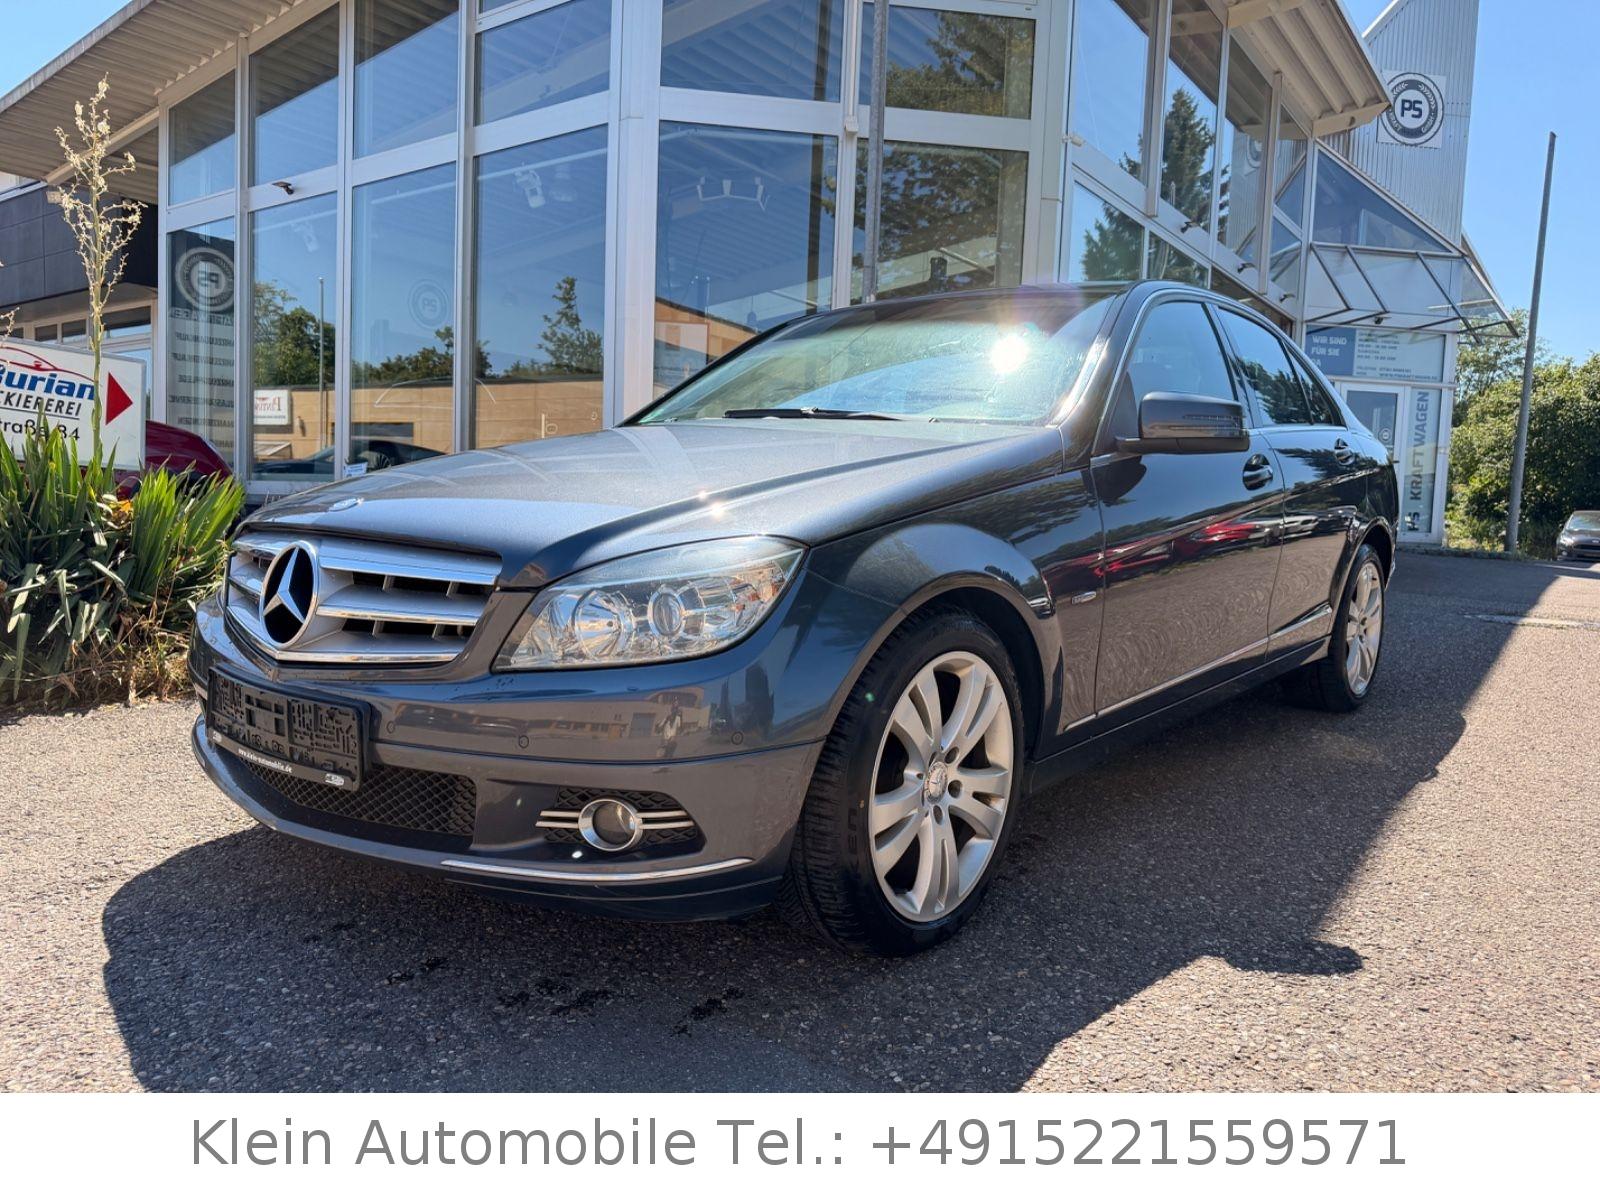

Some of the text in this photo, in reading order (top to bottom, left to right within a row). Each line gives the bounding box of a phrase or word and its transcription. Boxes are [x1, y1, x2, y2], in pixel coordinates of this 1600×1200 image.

[1312, 335, 1347, 345] WIR SIND
[1311, 345, 1340, 357] FÜR SIE
[0, 390, 81, 417] KIEREREI
[1410, 391, 1429, 500] KRAFTWAGEN
